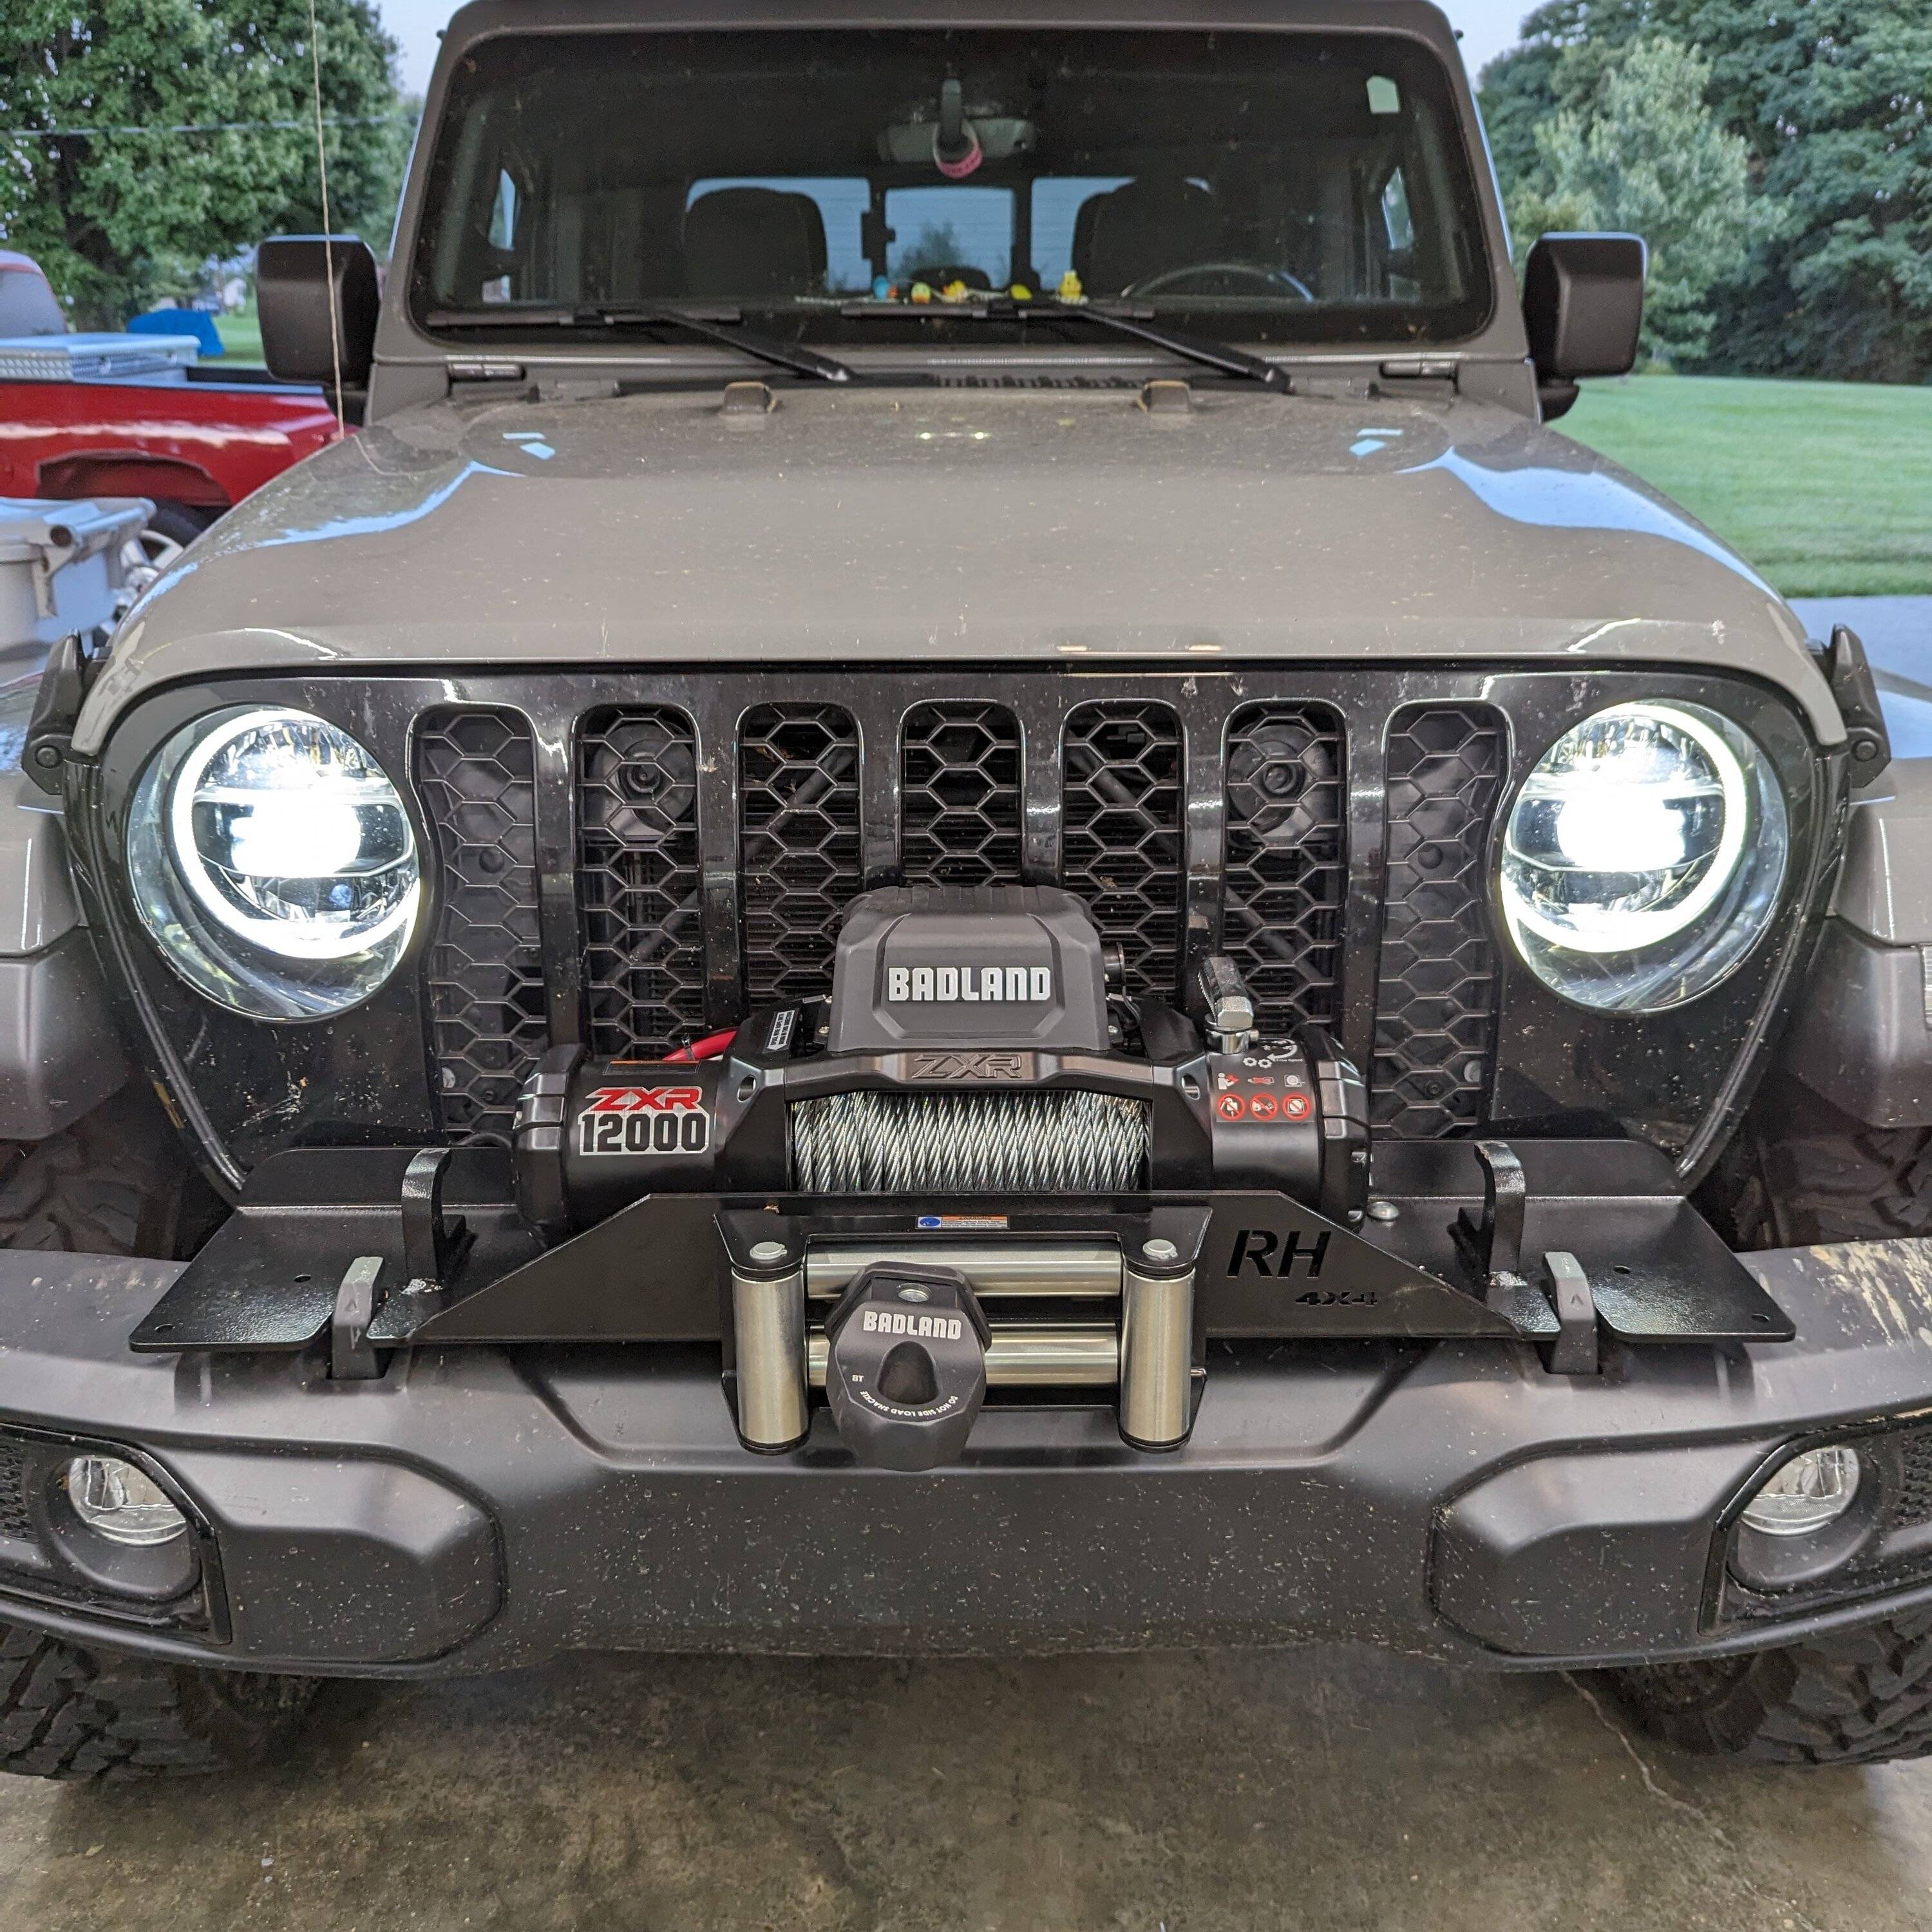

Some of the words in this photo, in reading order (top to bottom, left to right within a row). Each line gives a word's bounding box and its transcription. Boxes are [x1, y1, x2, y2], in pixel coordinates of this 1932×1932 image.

[889, 967, 1050, 1001] BADLAND
[911, 1054, 1021, 1079] ZXR
[587, 1088, 702, 1112] ZXR
[582, 1113, 707, 1153] 12000
[1227, 1229, 1332, 1278] RH
[863, 1311, 961, 1340] BADLAND
[891, 1408, 916, 1417] LOAD
[936, 1403, 951, 1413] NOT
